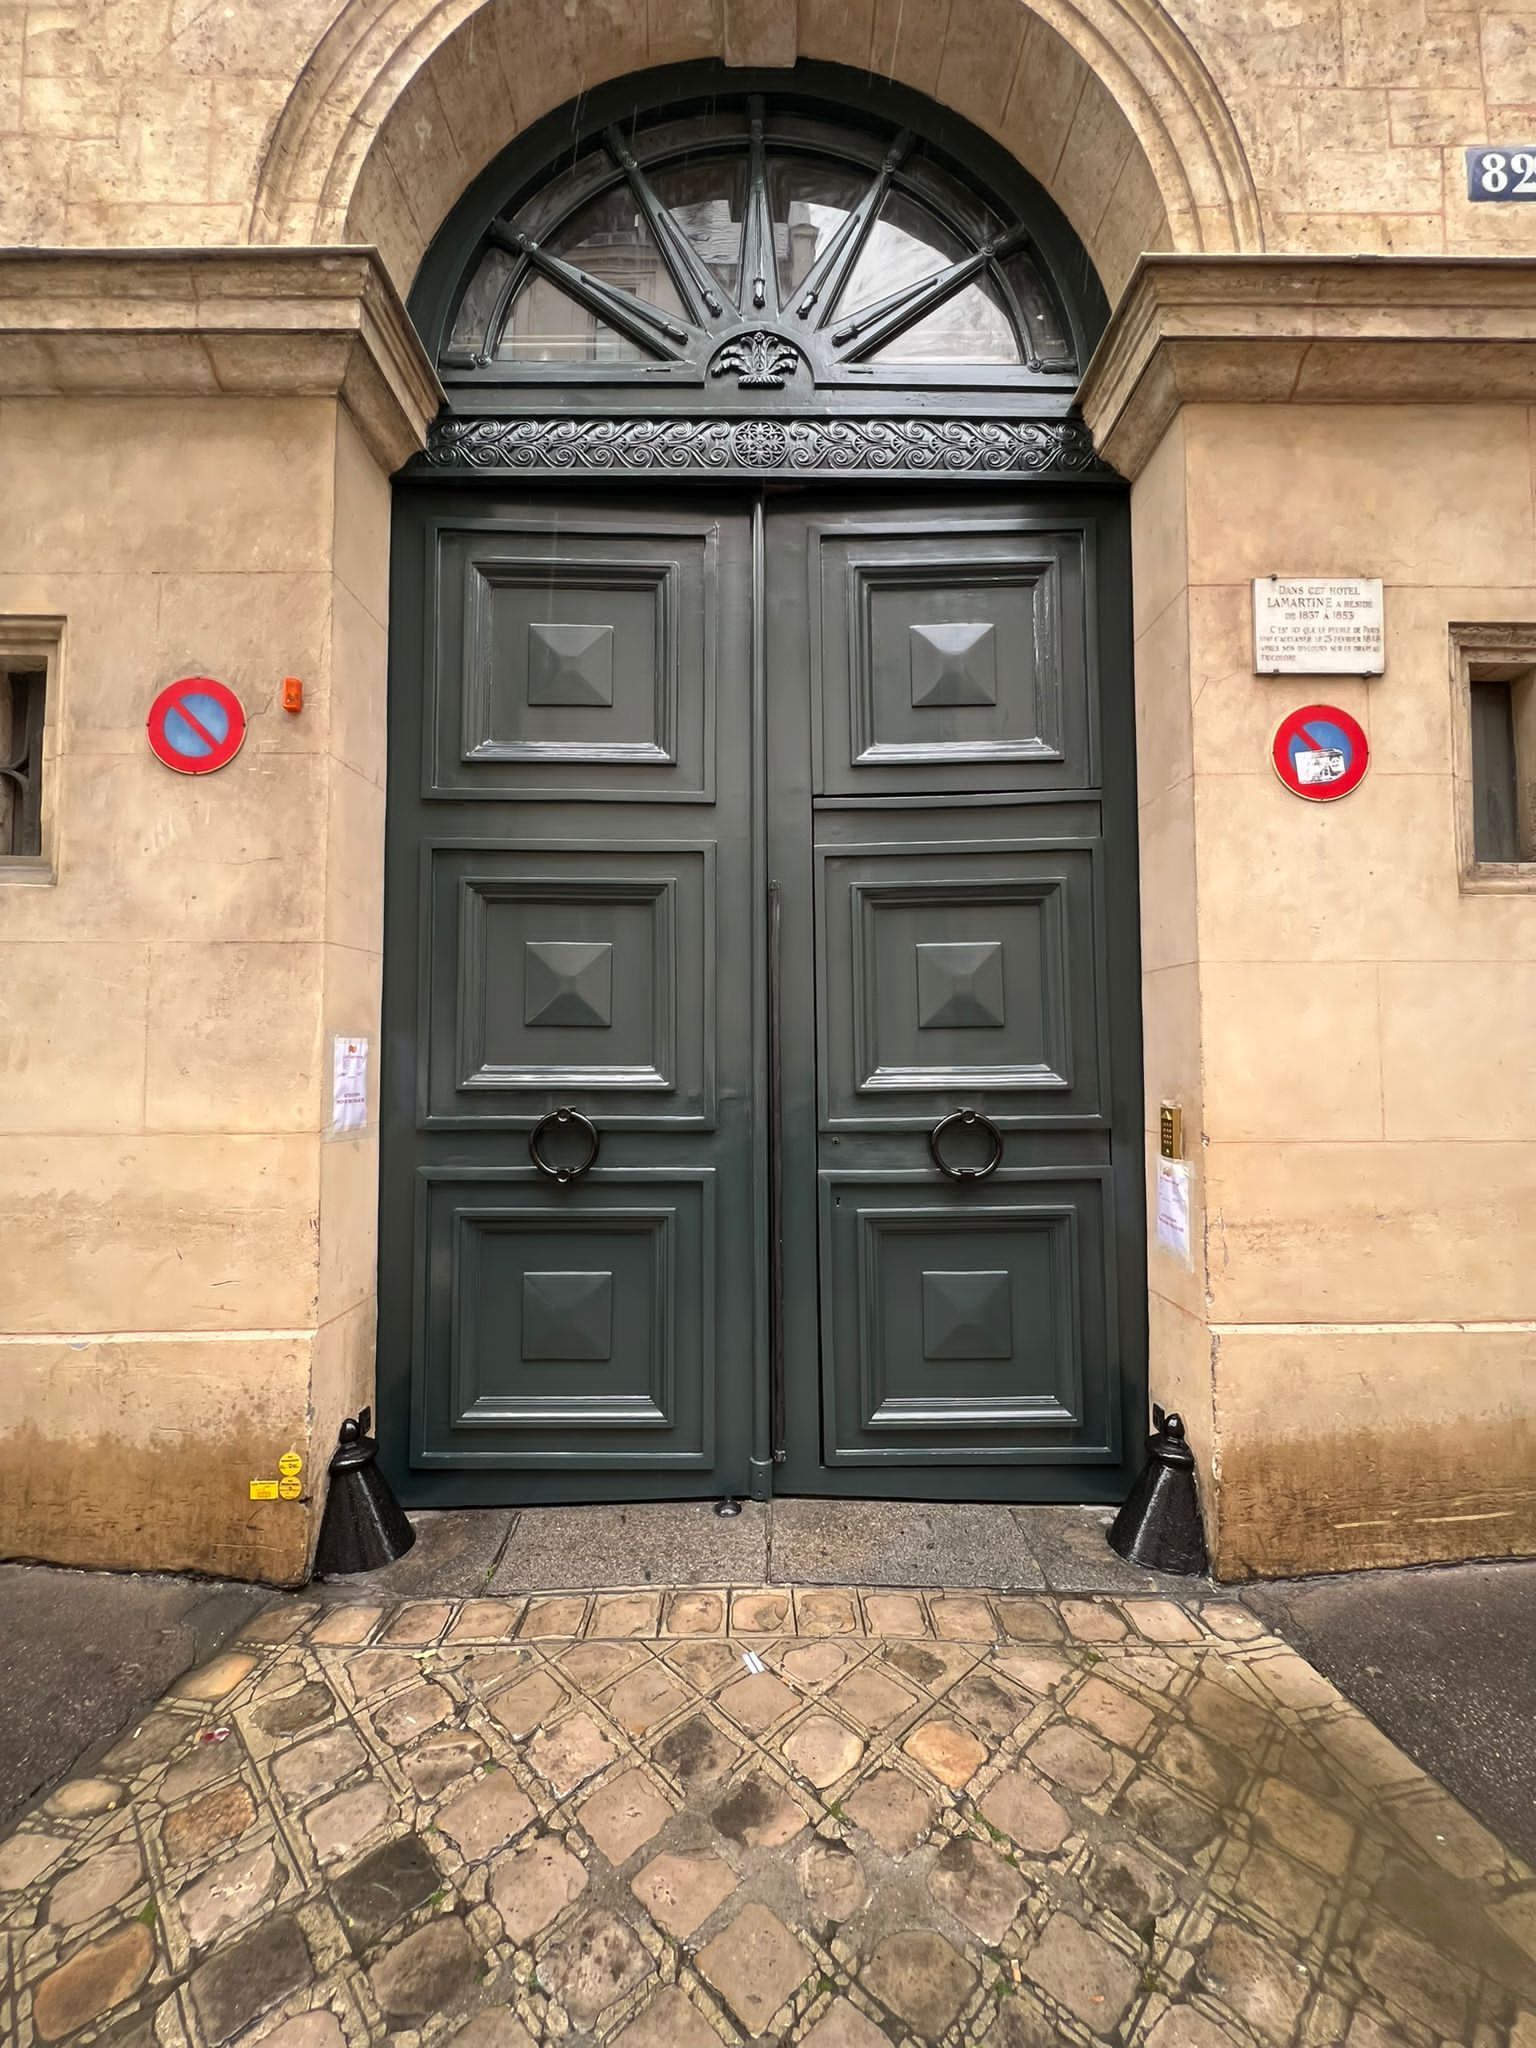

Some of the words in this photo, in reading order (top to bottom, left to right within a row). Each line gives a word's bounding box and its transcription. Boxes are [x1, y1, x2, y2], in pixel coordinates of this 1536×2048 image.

[1481, 153, 1536, 193] 82
[1279, 585, 1304, 595] DANS
[1308, 587, 1325, 595] CET
[1267, 598, 1334, 608] LAMARTINE
[1299, 611, 1320, 620] 1837
[1333, 611, 1355, 620] 1853
[1353, 626, 1361, 634] DE
